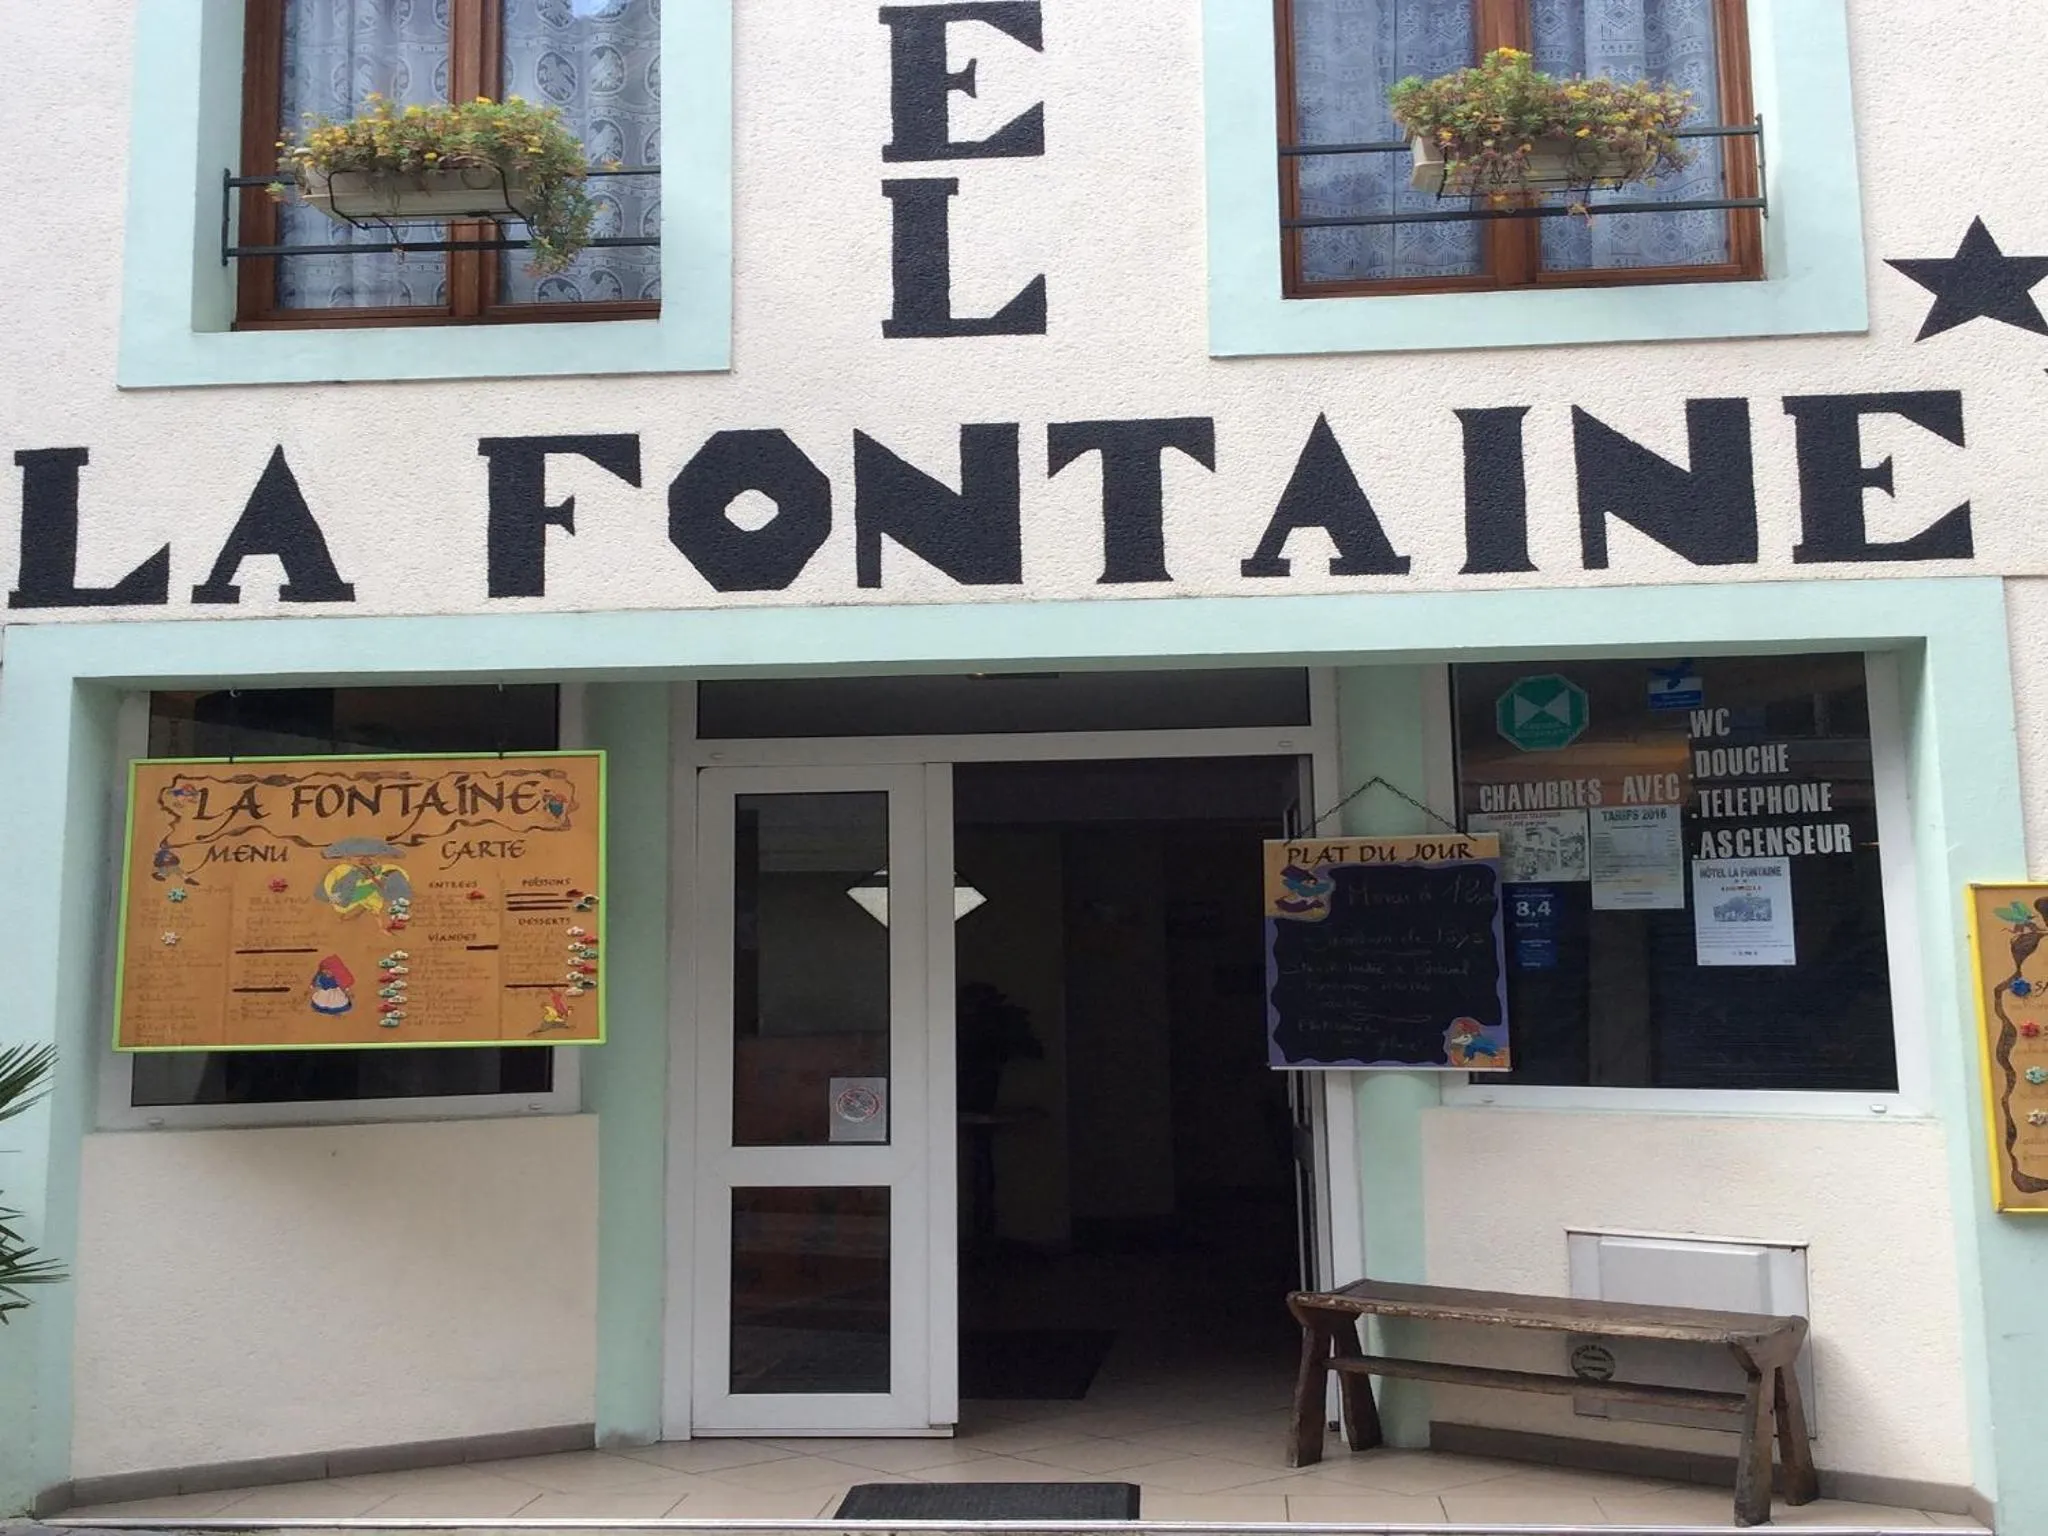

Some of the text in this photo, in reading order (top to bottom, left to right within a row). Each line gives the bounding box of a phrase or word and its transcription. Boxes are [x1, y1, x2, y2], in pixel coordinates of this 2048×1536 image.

[9, 391, 1973, 608] LA FONTAINE
[1479, 773, 1680, 812] CHAMBRES AVEC
[193, 784, 271, 840] LA
[188, 845, 288, 874] MENU
[439, 840, 526, 870] CARTE
[1287, 842, 1475, 865] PLAT DU JOUR
[1516, 901, 1552, 917] 8,4
